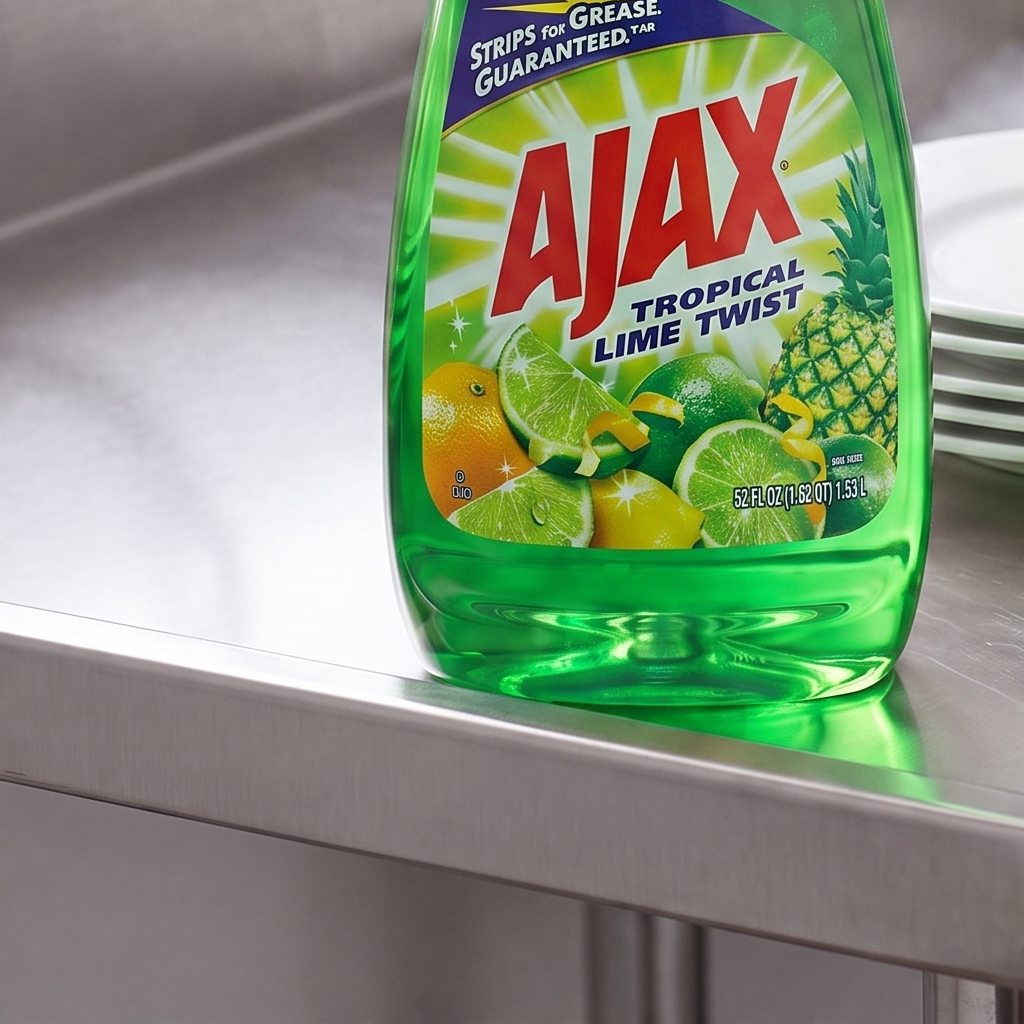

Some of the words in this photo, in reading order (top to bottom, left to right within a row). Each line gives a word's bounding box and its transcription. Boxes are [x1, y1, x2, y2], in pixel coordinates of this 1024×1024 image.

[470, 24, 536, 71] STRIPS
[474, 28, 630, 98] GUARANTEED.
[490, 76, 802, 341] AJAX
[594, 319, 682, 363] LIME
[695, 283, 804, 336] TWIST
[631, 259, 805, 323] TROPICAL
[734, 488, 749, 508] 52
[751, 487, 765, 507] FL
[767, 486, 782, 506] OZ
[835, 478, 858, 500] 1.53
[860, 476, 867, 497] L
